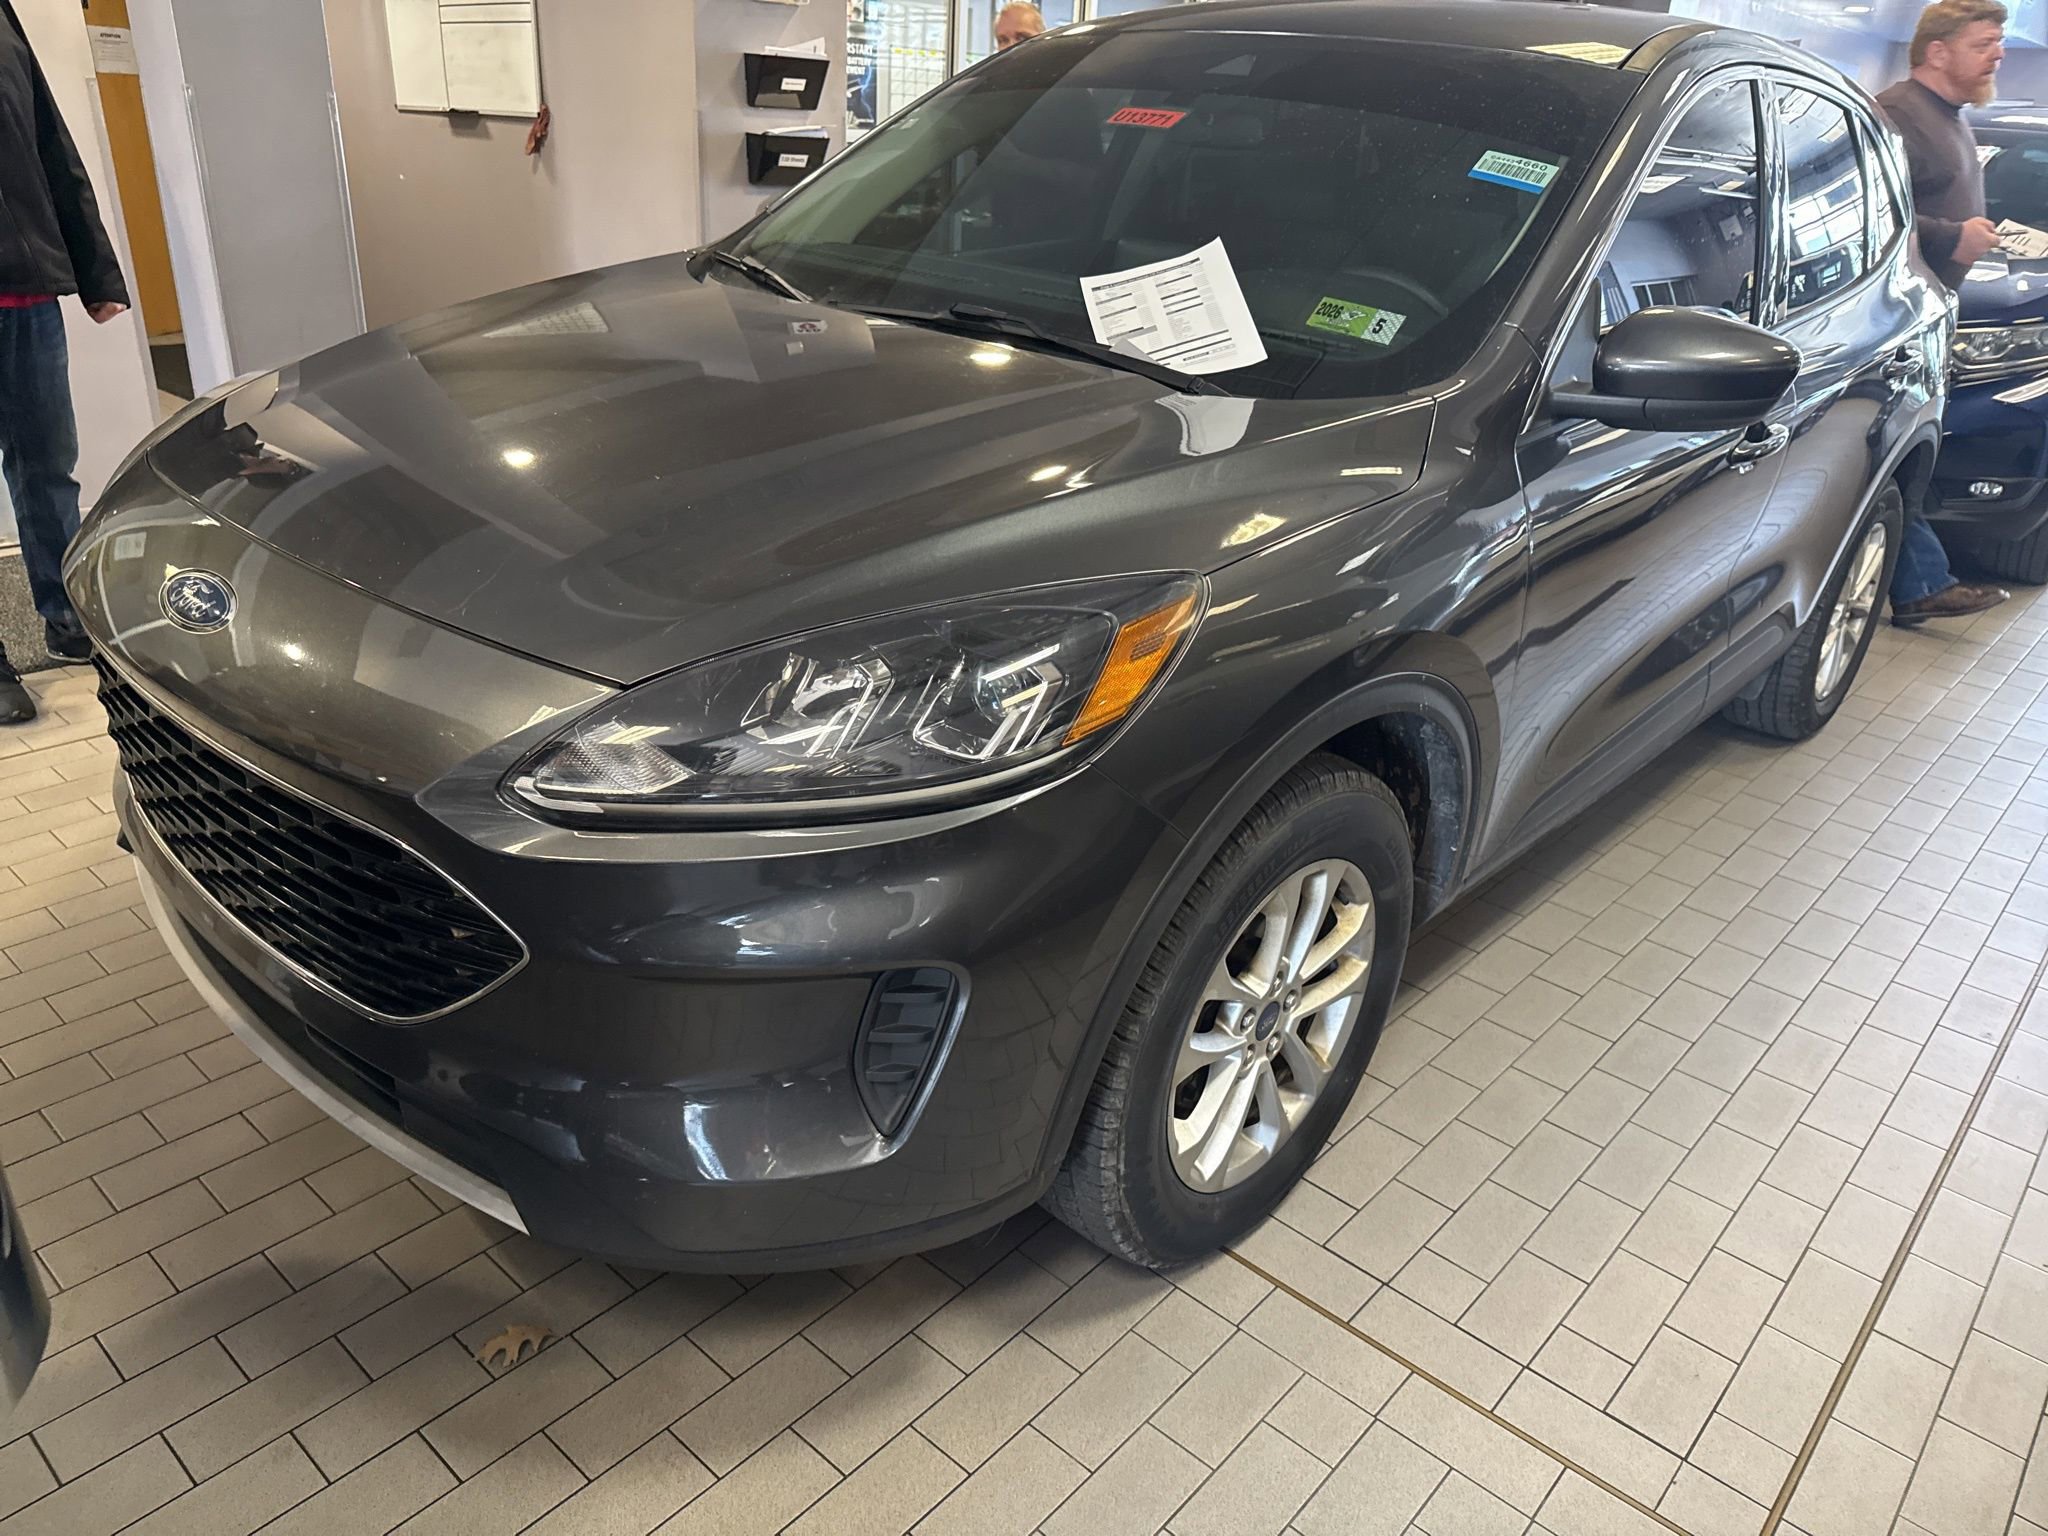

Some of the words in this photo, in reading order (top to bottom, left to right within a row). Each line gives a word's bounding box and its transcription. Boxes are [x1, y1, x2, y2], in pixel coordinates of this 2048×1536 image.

[1112, 110, 1175, 126] U13771
[1315, 301, 1345, 319] 2026
[1371, 317, 1388, 335] 5
[170, 579, 217, 618] Ford
